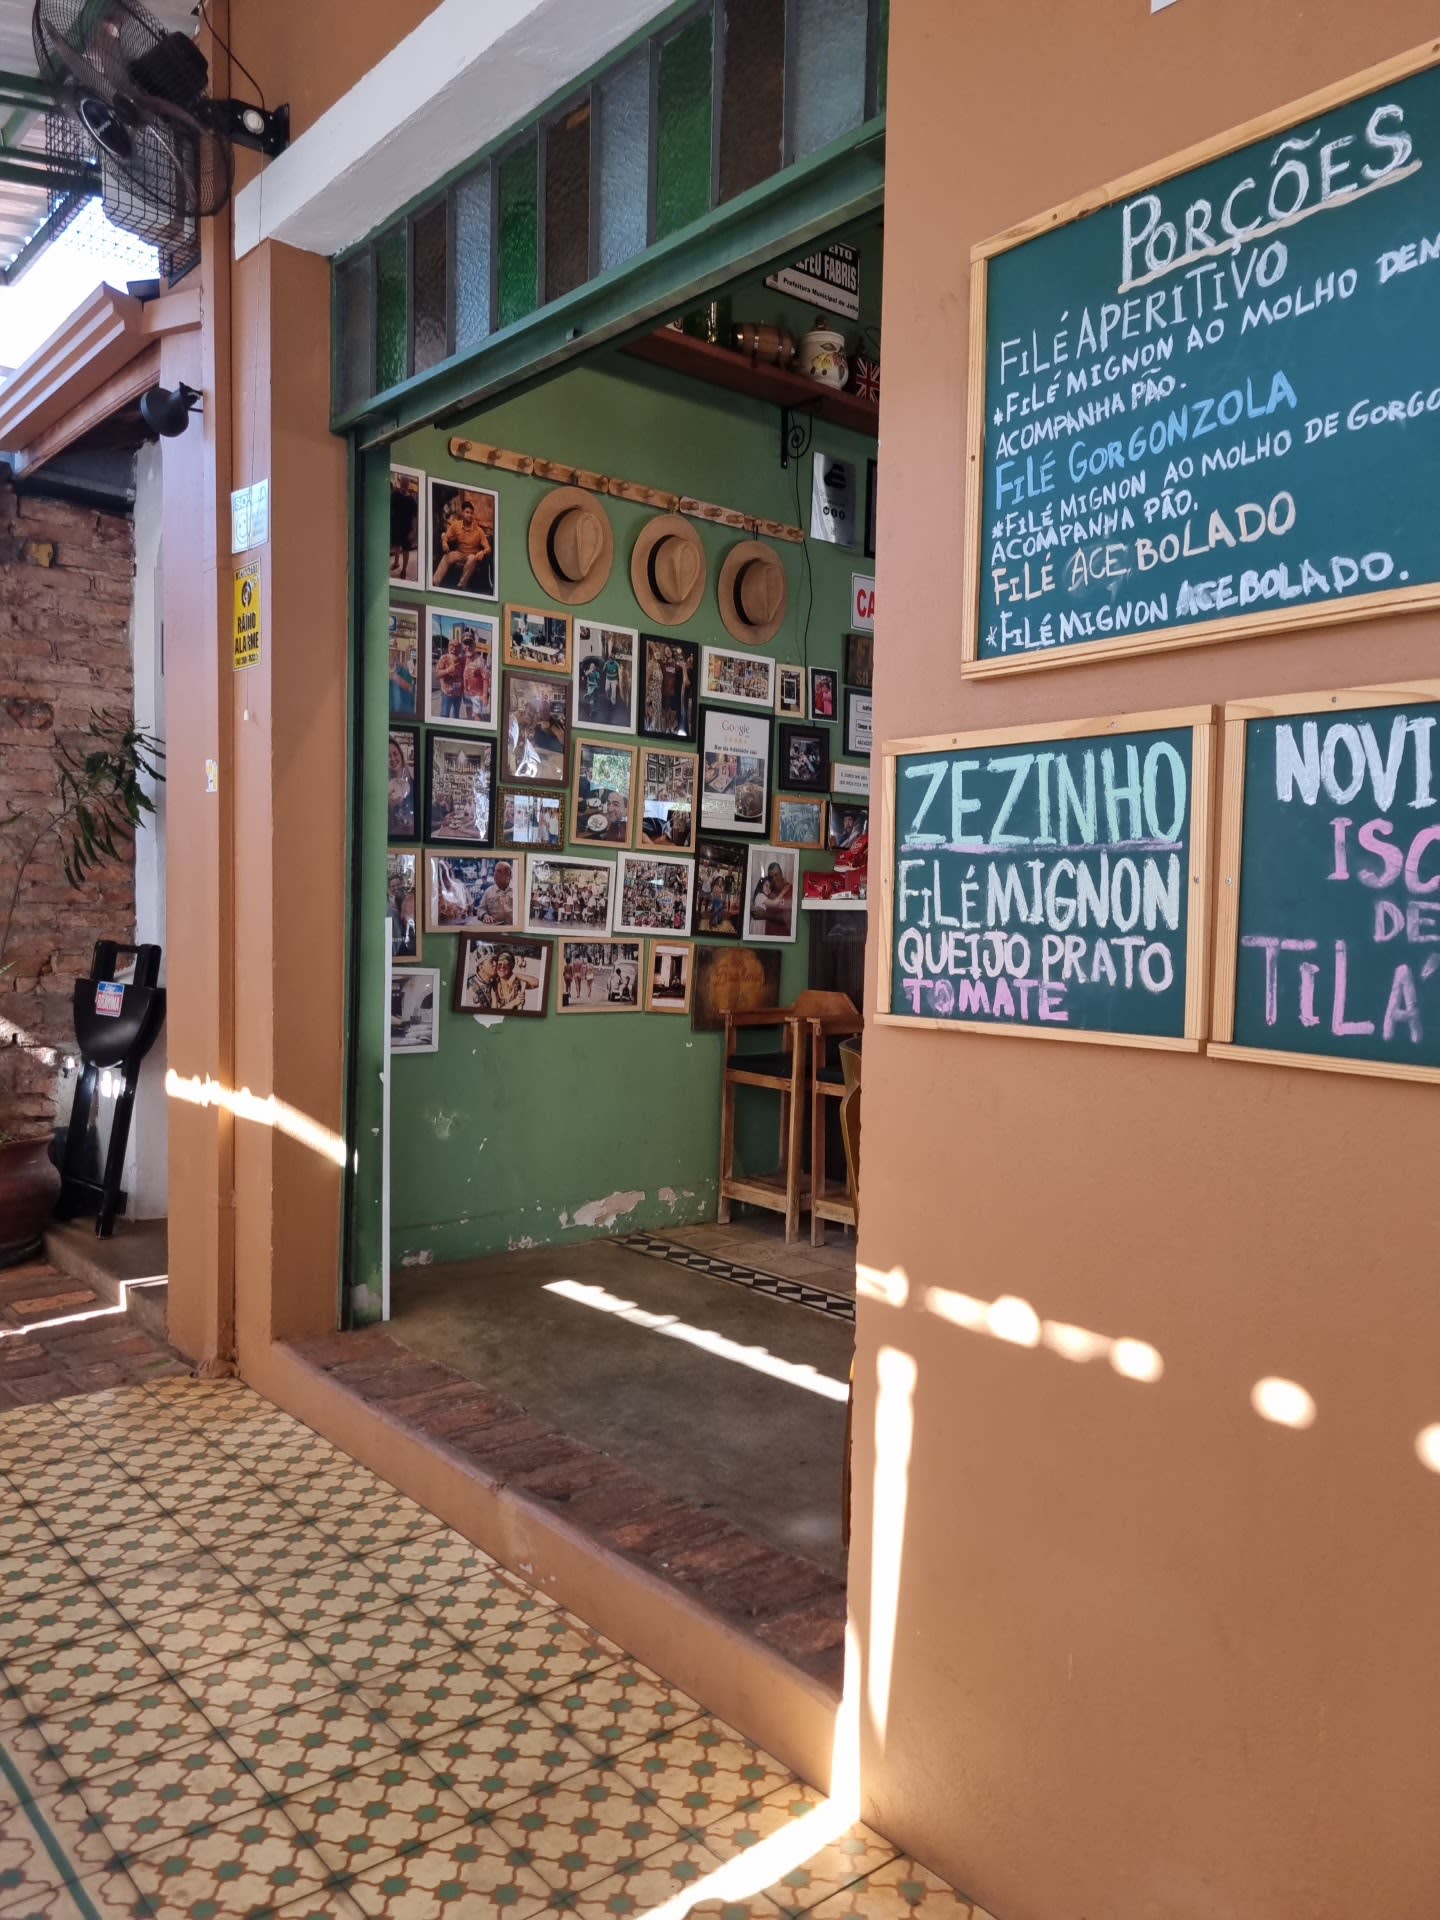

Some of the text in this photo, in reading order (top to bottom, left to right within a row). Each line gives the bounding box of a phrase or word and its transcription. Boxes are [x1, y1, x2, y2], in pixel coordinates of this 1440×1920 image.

[783, 276, 811, 294] Prefeitura
[812, 288, 838, 304] Municipal
[824, 254, 857, 292] FABRIS
[1000, 239, 1288, 386] FILÉ APERITIVO
[1066, 334, 1174, 397] MIGNON
[1186, 318, 1225, 354] AO
[1240, 268, 1358, 335] MOLHO
[995, 391, 1126, 460] ACOMPANHA
[995, 369, 1298, 510] FILÉ GORGONZOLA
[1060, 469, 1146, 522] MIGNON
[1163, 456, 1194, 489] AO
[1201, 429, 1292, 477] MOLHO
[1304, 411, 1340, 444] DE
[991, 505, 1135, 566] ACOMPANHA
[991, 552, 1056, 606] FILÉ
[1059, 591, 1169, 643] MIGNON
[721, 719, 751, 737] Google
[904, 741, 1187, 846] ZEZINHO
[898, 852, 1181, 933] FILÉ MIGNON
[897, 926, 1174, 993] QUEIJO PRATO
[902, 977, 1069, 1022] TOMATE
